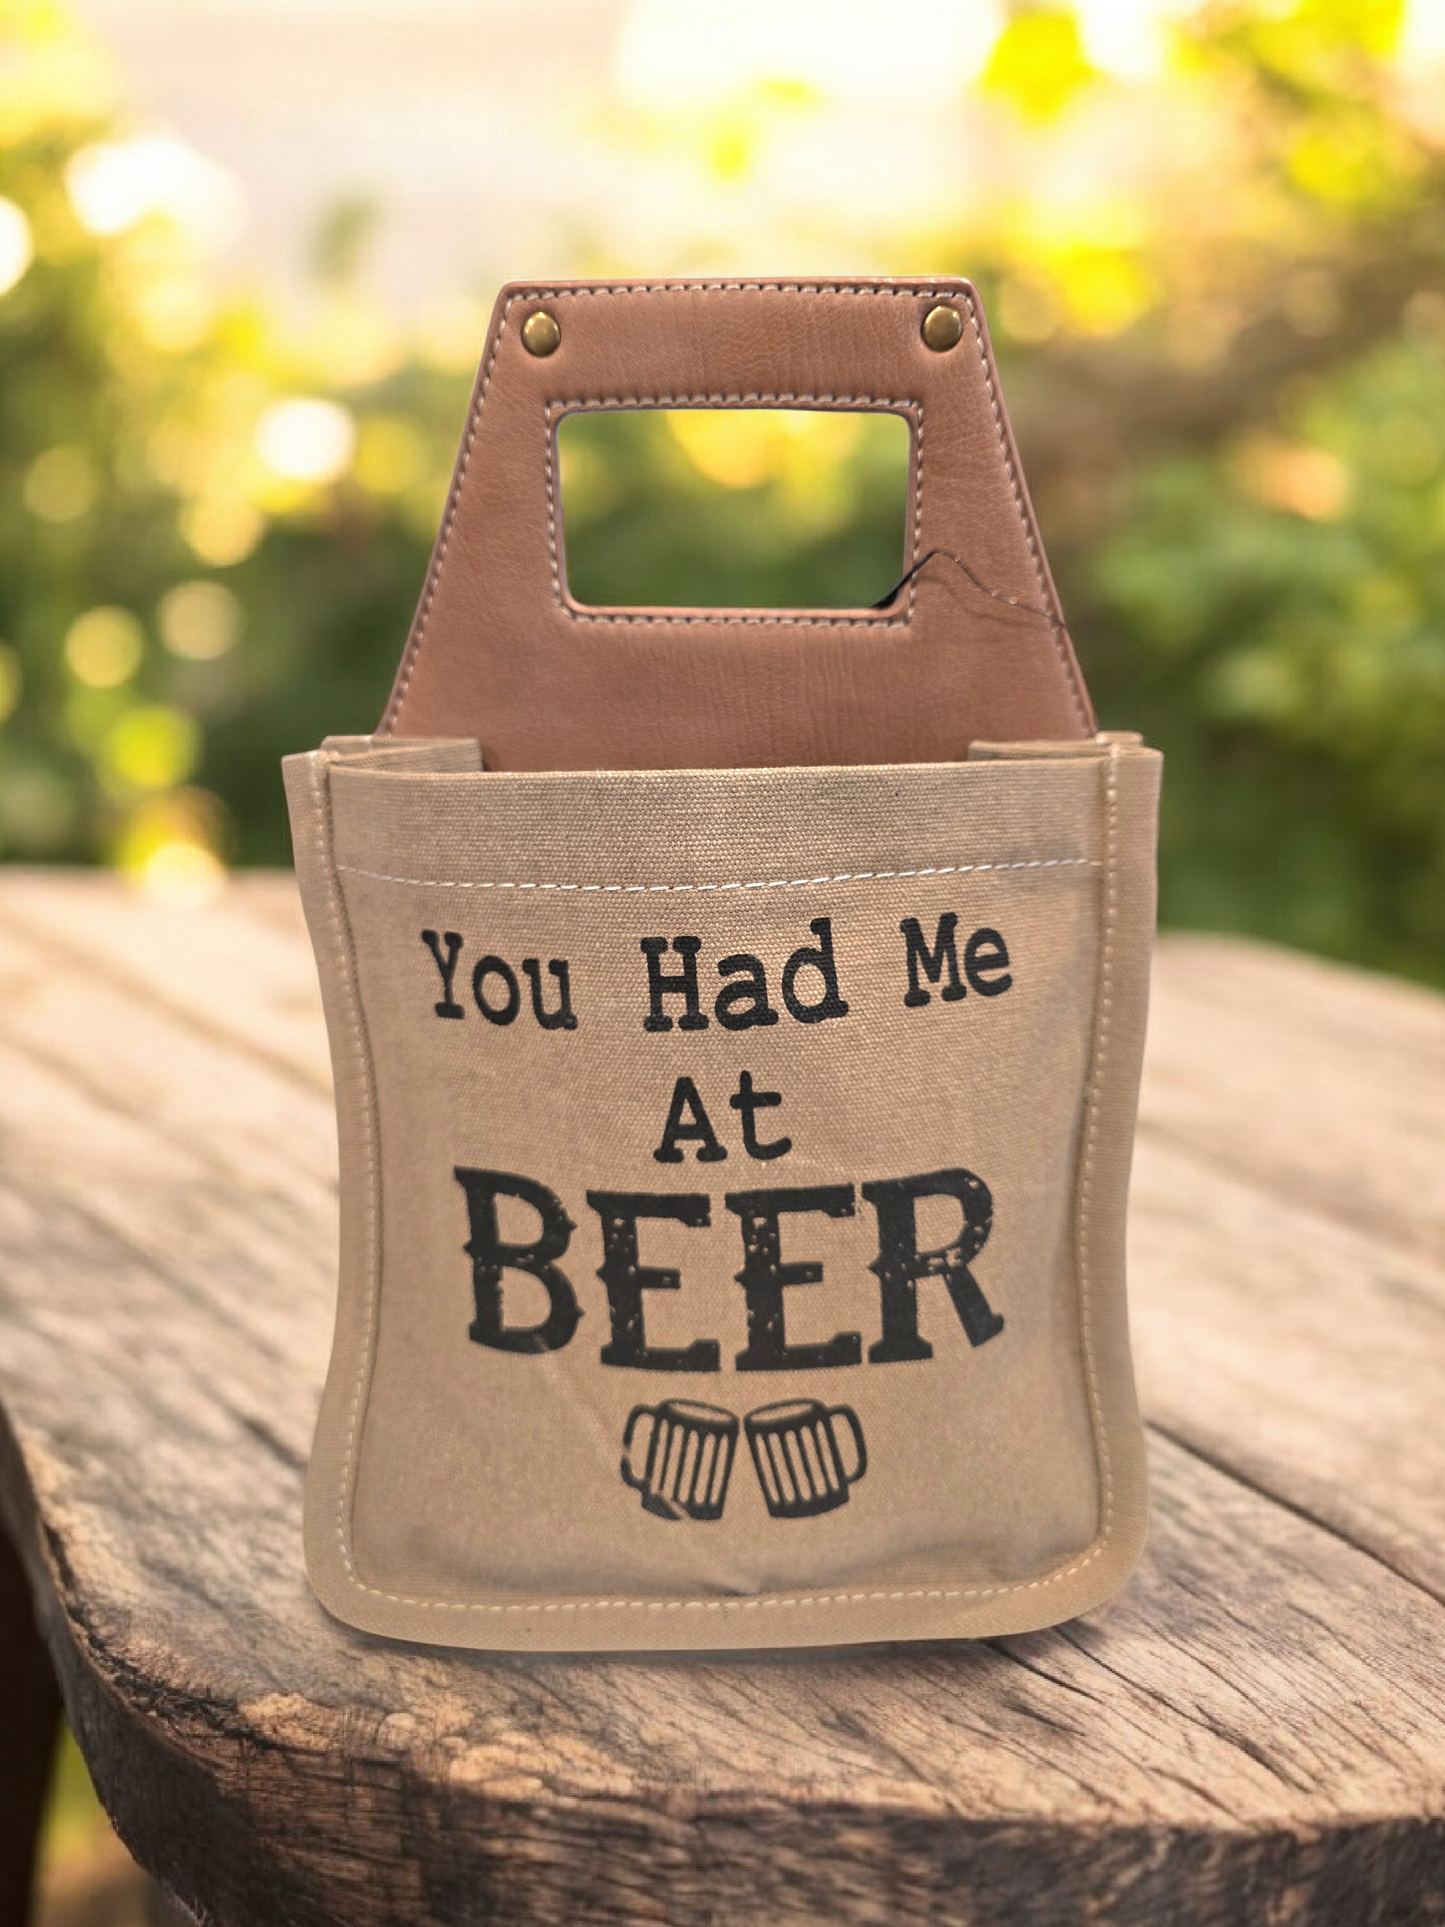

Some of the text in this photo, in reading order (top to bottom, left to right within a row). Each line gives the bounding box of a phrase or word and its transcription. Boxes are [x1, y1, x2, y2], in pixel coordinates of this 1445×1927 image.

[421, 911, 1013, 1033] You Had Me
[652, 1069, 793, 1163] At
[453, 1165, 1005, 1373] BEER
